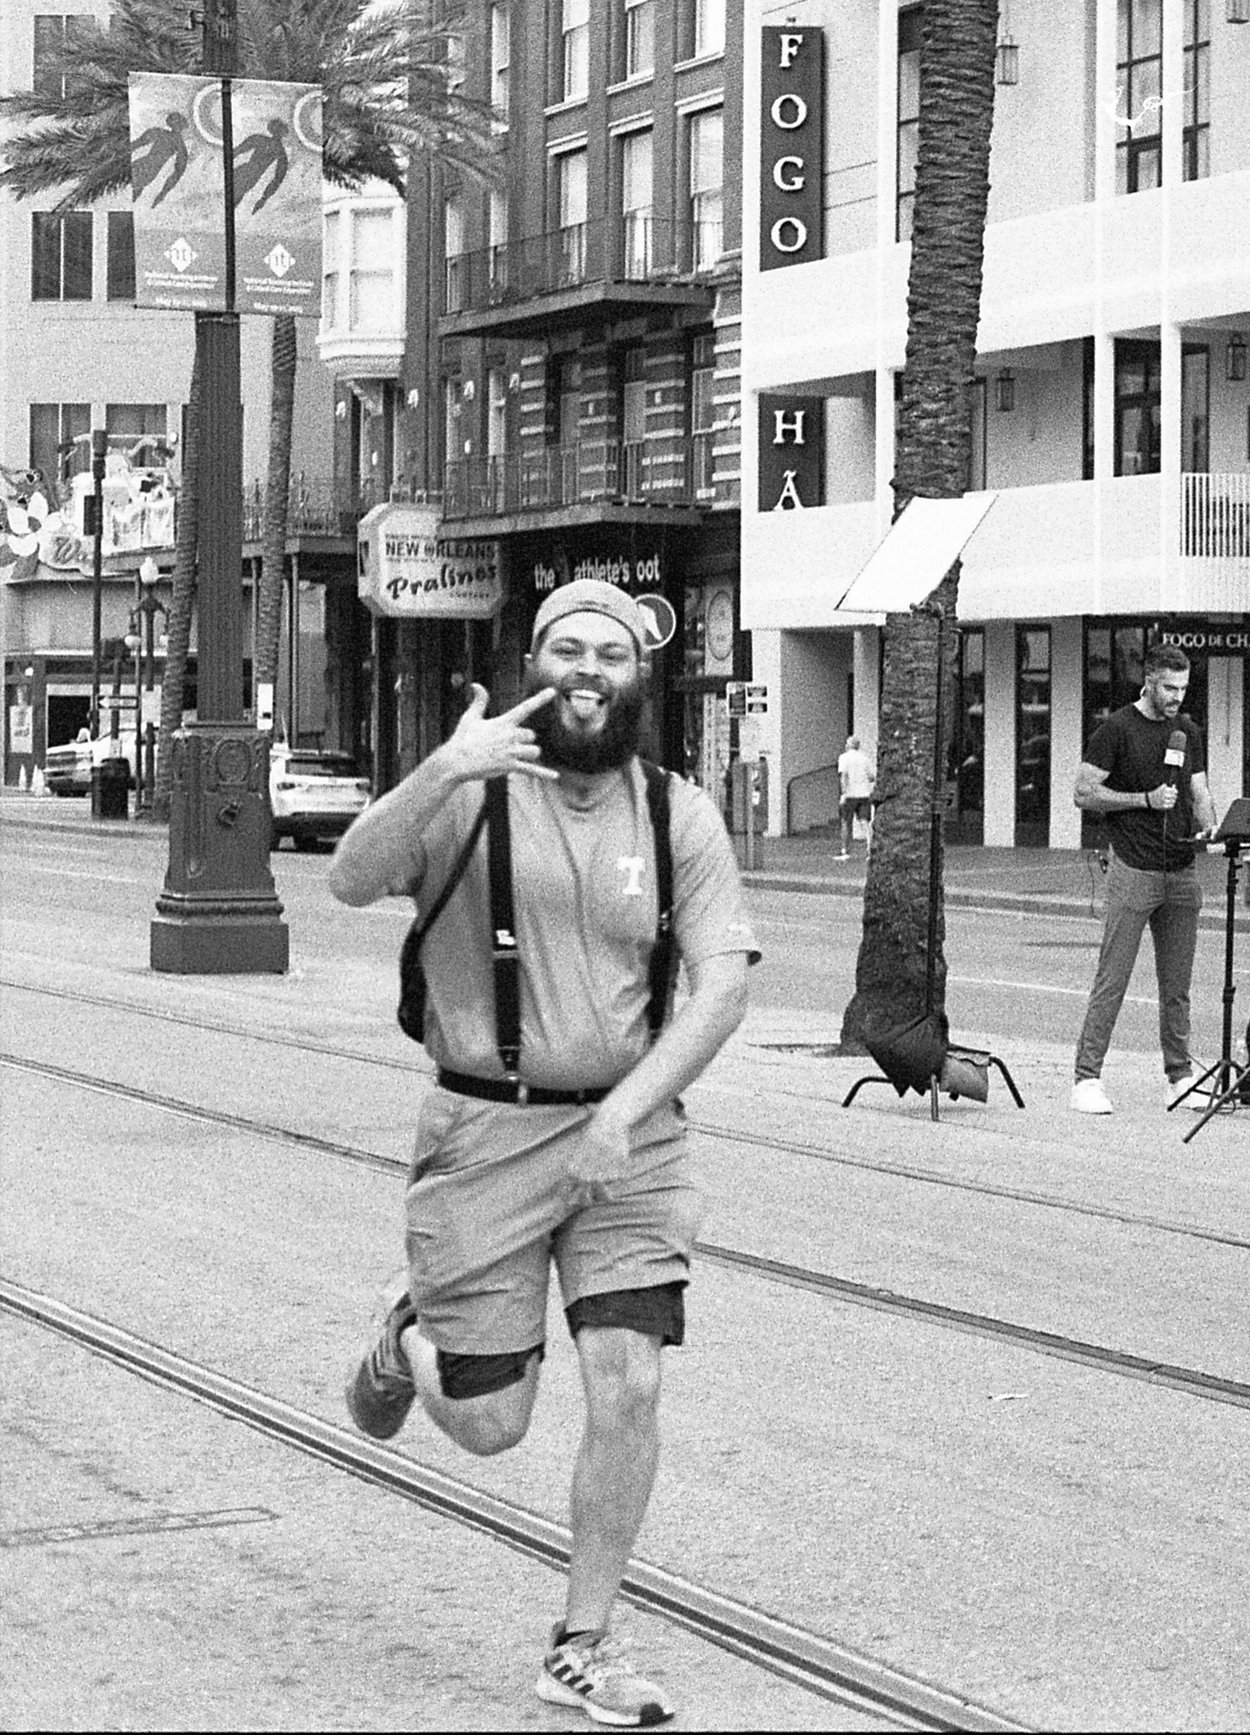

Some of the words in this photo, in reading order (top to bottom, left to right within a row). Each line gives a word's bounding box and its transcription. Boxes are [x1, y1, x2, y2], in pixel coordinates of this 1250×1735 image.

[770, 34, 808, 252] FOGO
[385, 541, 420, 556] NEW
[386, 562, 497, 600] Pralines
[534, 561, 556, 590] the
[1162, 632, 1206, 648] FOGO
[1208, 634, 1223, 647] DE
[617, 855, 647, 895] T
